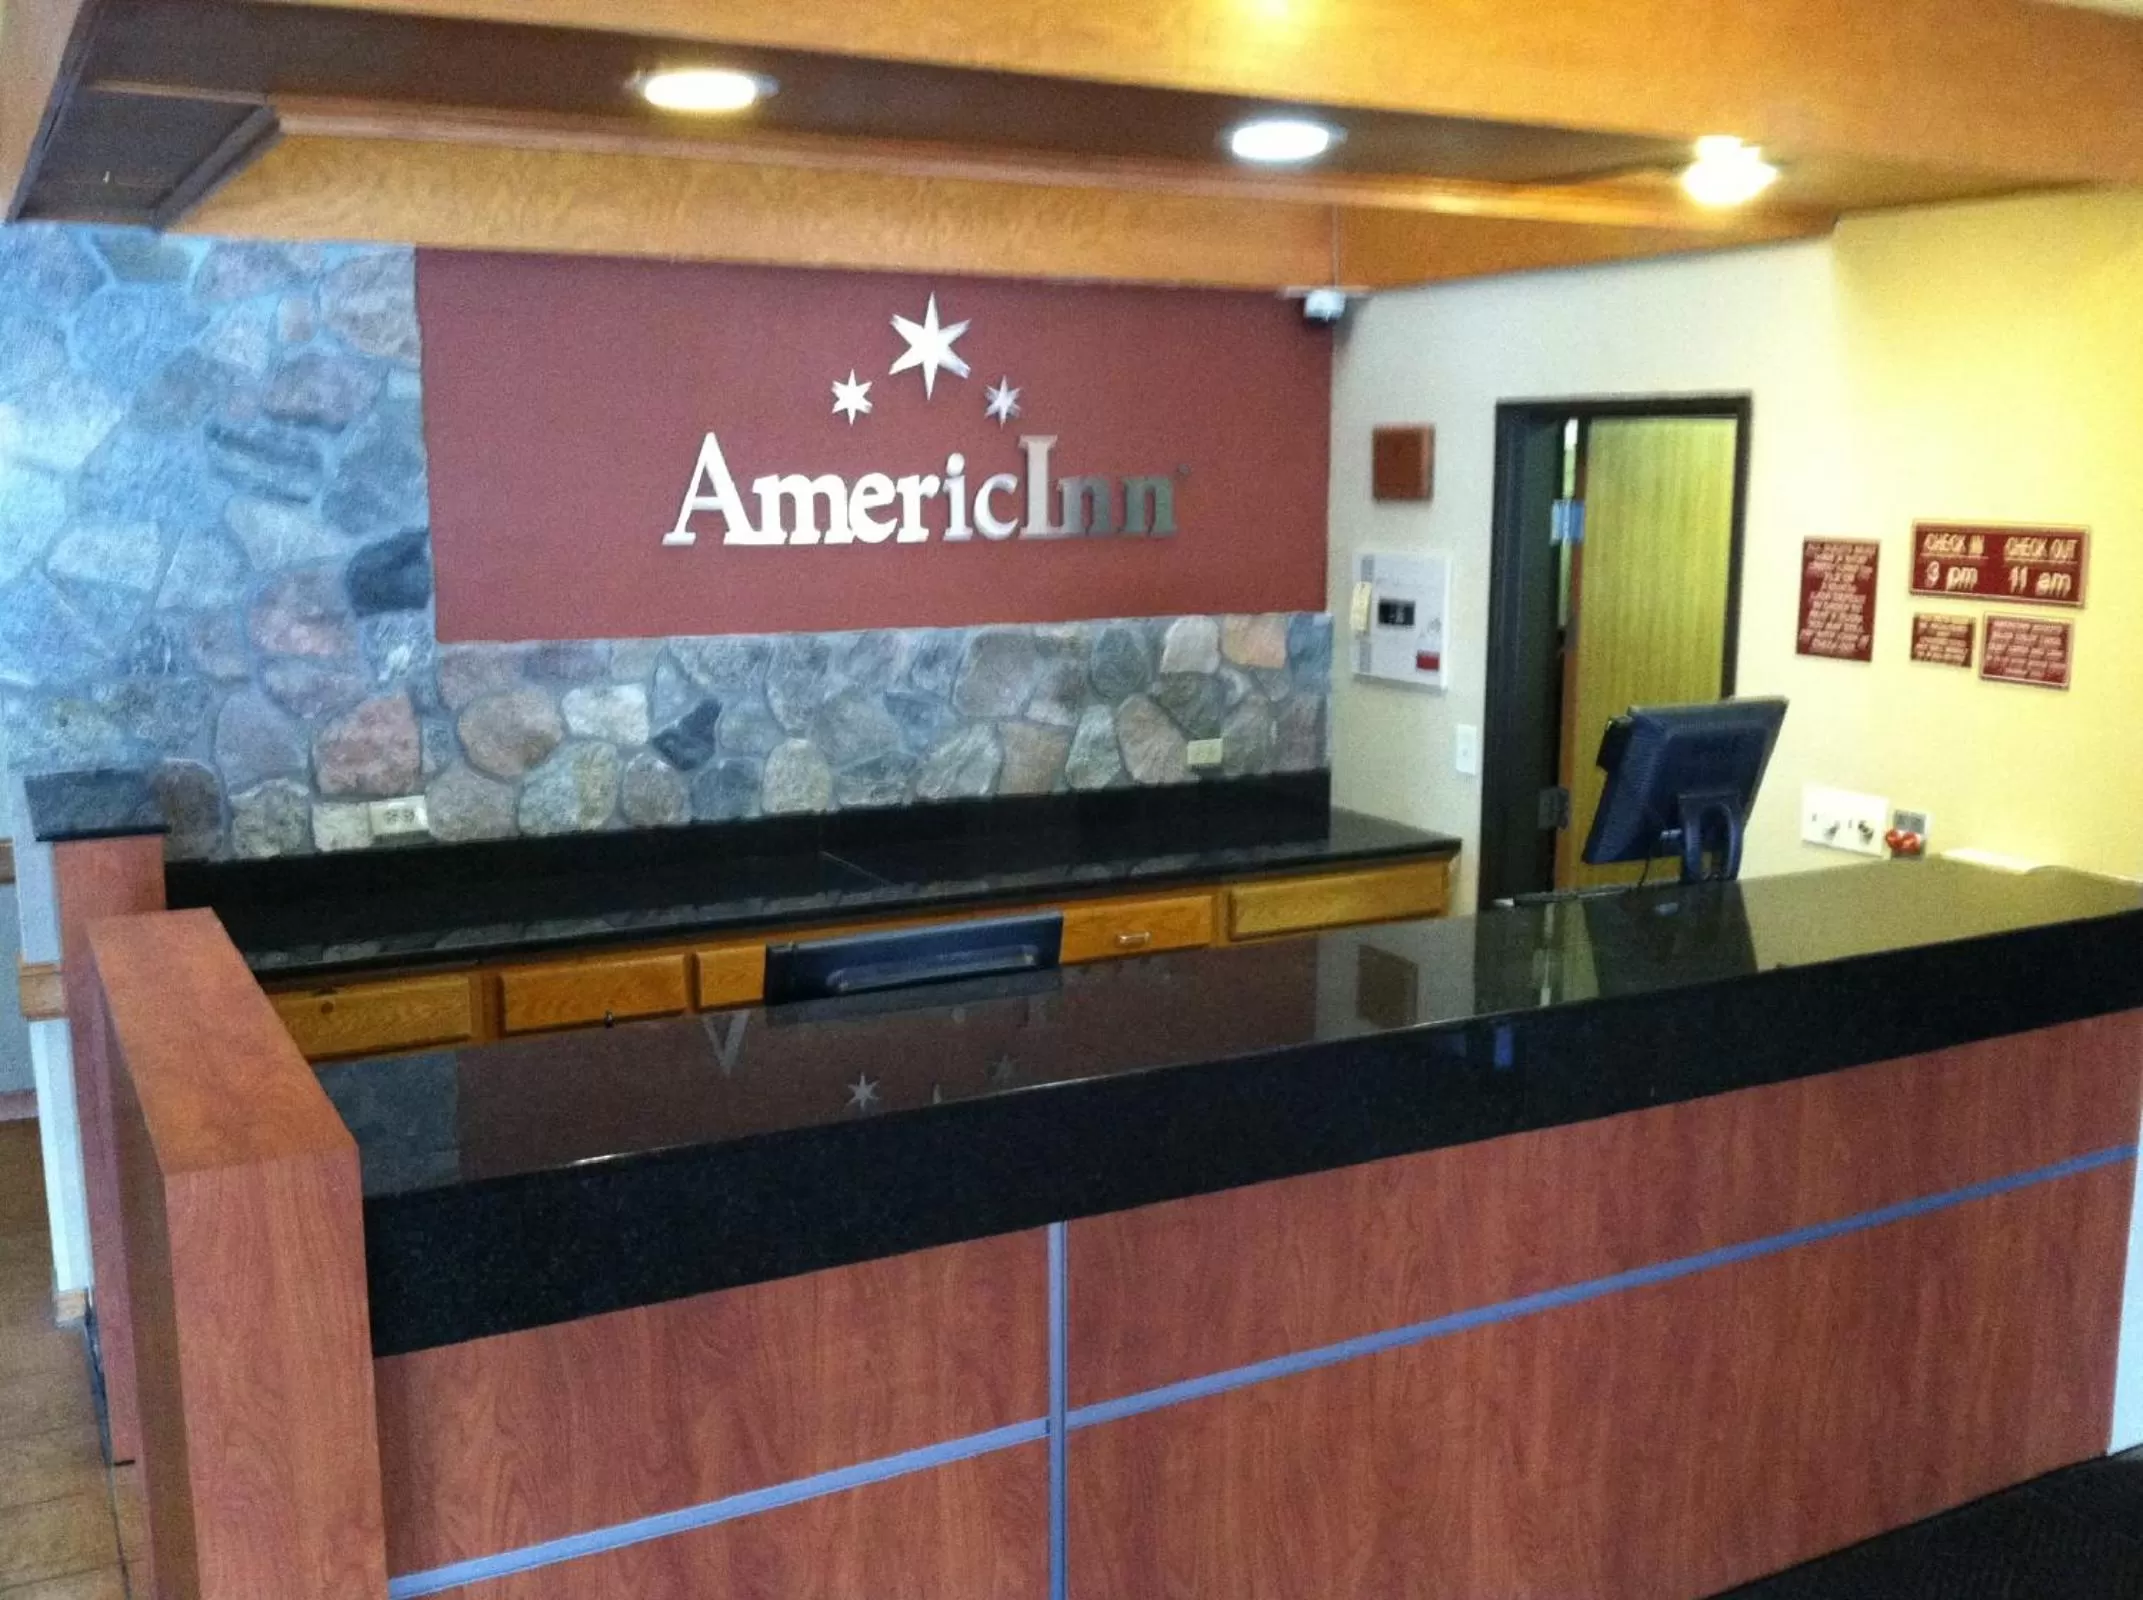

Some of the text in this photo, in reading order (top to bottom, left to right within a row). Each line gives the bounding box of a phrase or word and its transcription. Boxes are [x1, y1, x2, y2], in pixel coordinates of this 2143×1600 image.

[662, 431, 1177, 546] AmericInn
[1923, 533, 1985, 556] CHECK IN
[2004, 536, 2079, 560] CHECK OUT
[1925, 560, 1979, 591] 3 pm
[2008, 565, 2072, 598] 11 am
